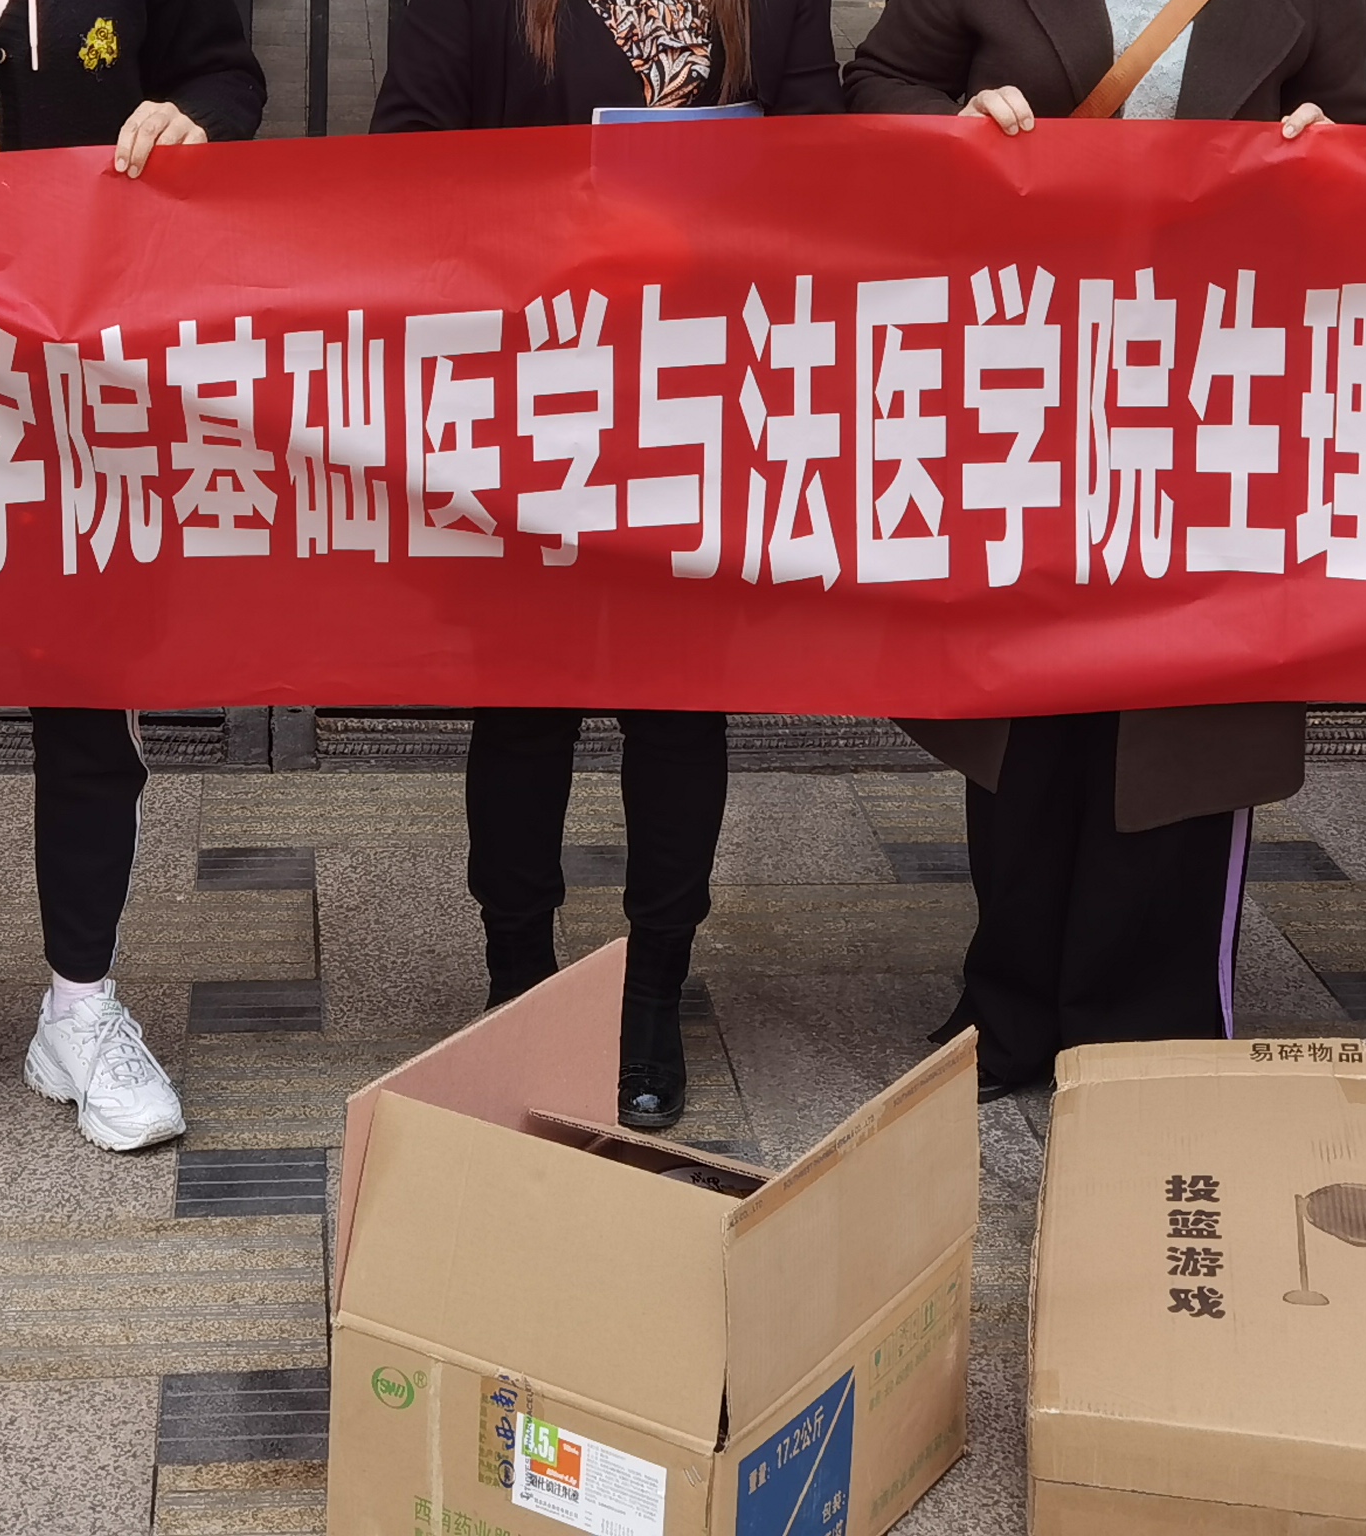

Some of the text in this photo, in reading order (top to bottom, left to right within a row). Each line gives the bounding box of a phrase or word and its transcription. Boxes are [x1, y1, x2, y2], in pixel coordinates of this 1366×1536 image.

[1248, 1041, 1365, 1065] 易碎物品
[1164, 1174, 1226, 1319] 投篮游戏
